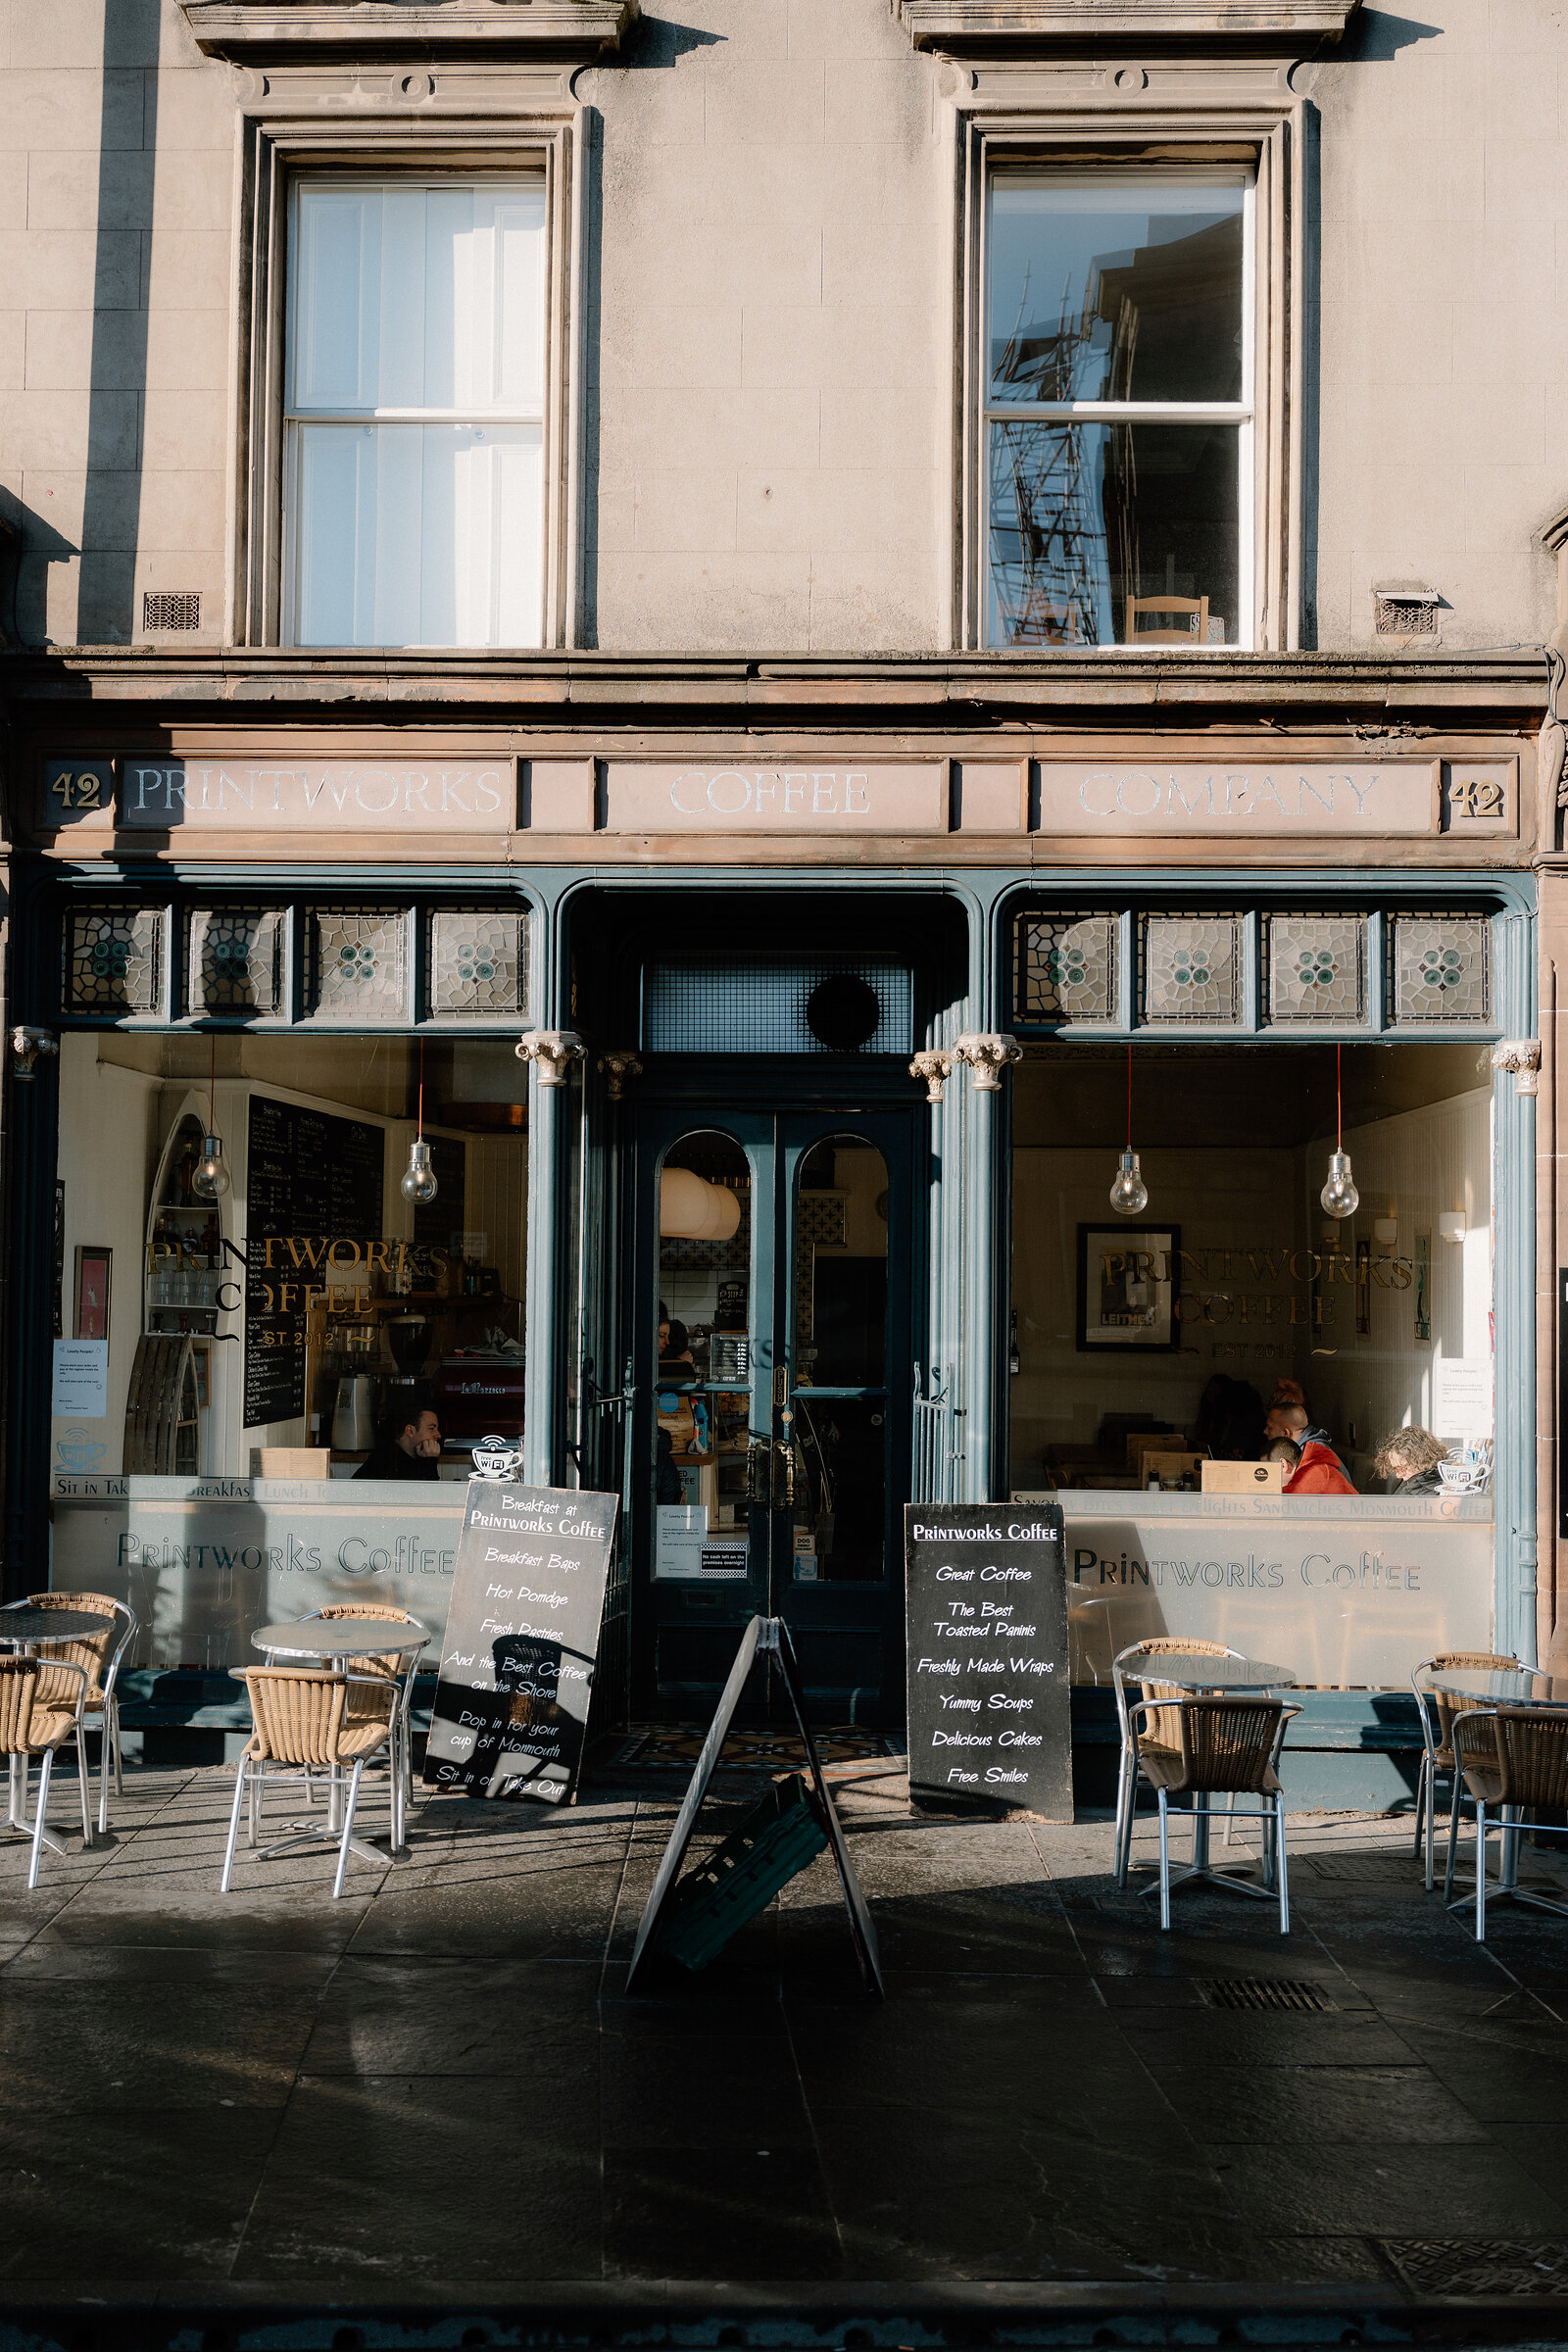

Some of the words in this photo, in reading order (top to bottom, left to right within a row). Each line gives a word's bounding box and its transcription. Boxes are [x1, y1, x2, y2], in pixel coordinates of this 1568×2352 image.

[52, 772, 101, 808] 42
[133, 768, 502, 813] PRINTWORKS
[670, 771, 870, 814] COFFEE
[1079, 773, 1379, 816] COMPANY
[1449, 781, 1504, 818] 42
[143, 1237, 450, 1280] PRINTWORKS
[1100, 1249, 1414, 1291] PRINTWORKS
[1175, 1294, 1338, 1326] COFFEE
[262, 1331, 287, 1347] ST
[294, 1332, 334, 1347] 2012
[1212, 1343, 1247, 1357] EST
[1254, 1343, 1296, 1357] 2012
[57, 1479, 77, 1494] Sit
[84, 1480, 98, 1494] in
[104, 1480, 128, 1494] Tak
[502, 1494, 561, 1516] Breakfast
[565, 1503, 578, 1518] at
[1349, 1499, 1433, 1516] Monmouth
[470, 1509, 553, 1535] Printworks
[559, 1519, 606, 1540] Coffee
[913, 1524, 1002, 1540] Printworks
[1007, 1524, 1057, 1540] Coffee
[117, 1533, 321, 1573] Printworks
[338, 1536, 455, 1575] Coffee
[484, 1546, 543, 1567] Breakfast
[547, 1551, 580, 1571] Baps
[936, 1566, 975, 1582] Great
[980, 1566, 1032, 1582] Coffee
[1074, 1547, 1283, 1589] Printworks
[1300, 1551, 1420, 1592] Coffee
[485, 1584, 513, 1599] Hot
[949, 1602, 975, 1617] The
[980, 1602, 1013, 1617] Best
[480, 1618, 513, 1636] Fresh
[518, 1622, 564, 1642] Pastries
[933, 1622, 990, 1638] Toasted
[995, 1622, 1036, 1638] Paninis
[445, 1651, 475, 1668] And
[479, 1653, 497, 1670] the
[501, 1656, 533, 1675] Best
[538, 1661, 587, 1682] Coffee
[916, 1658, 961, 1676] Freshly
[966, 1658, 1004, 1673] Made
[1009, 1657, 1054, 1676] Wraps
[471, 1679, 488, 1692] on
[493, 1678, 511, 1694] the
[515, 1678, 557, 1699] Shore
[939, 1694, 982, 1712] Yummy
[987, 1693, 1034, 1711] Soups
[459, 1710, 487, 1730] Pop
[492, 1716, 503, 1730] in
[507, 1715, 524, 1733] for
[528, 1723, 560, 1738] your
[450, 1735, 471, 1748] cup
[477, 1735, 495, 1749] of
[498, 1737, 561, 1758] Monmouth
[932, 1730, 993, 1746] Delicious
[998, 1730, 1043, 1746] Cakes
[436, 1765, 461, 1783] Sit
[464, 1771, 474, 1784] in
[503, 1774, 532, 1792] Take
[536, 1779, 565, 1796] Out
[947, 1768, 979, 1784] Free
[984, 1766, 1028, 1784] Smiles
